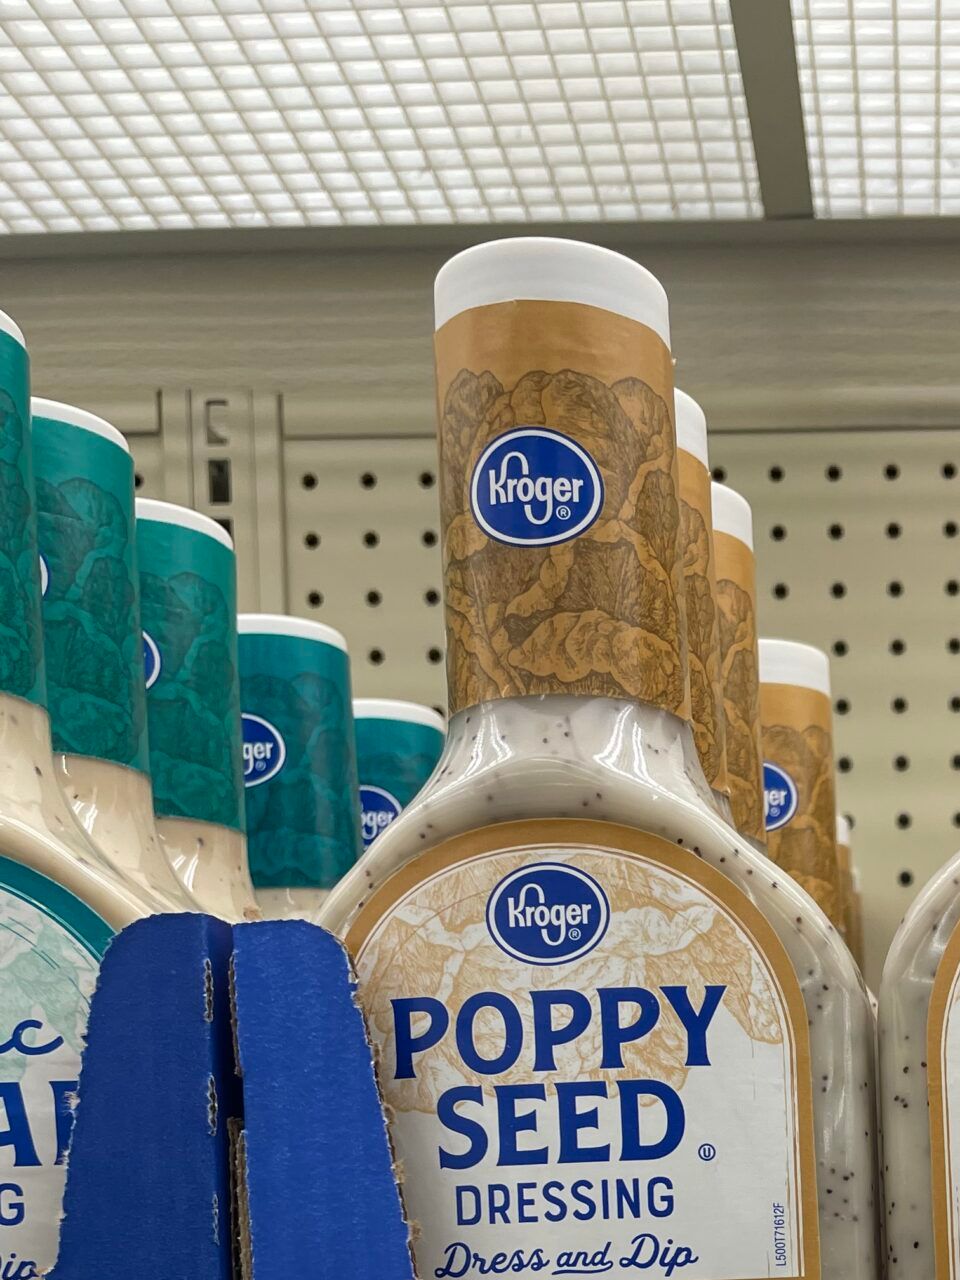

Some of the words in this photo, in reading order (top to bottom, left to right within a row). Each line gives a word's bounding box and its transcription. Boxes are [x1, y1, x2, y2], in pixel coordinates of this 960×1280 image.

[488, 451, 584, 525] Kroger
[507, 882, 592, 947] Kroger
[390, 984, 727, 1079] POPPY
[436, 1078, 686, 1170] SEED
[455, 1176, 675, 1226] DRESSING
[434, 1241, 550, 1279] Dress
[554, 1241, 613, 1275] and
[619, 1233, 699, 1277] Dip
